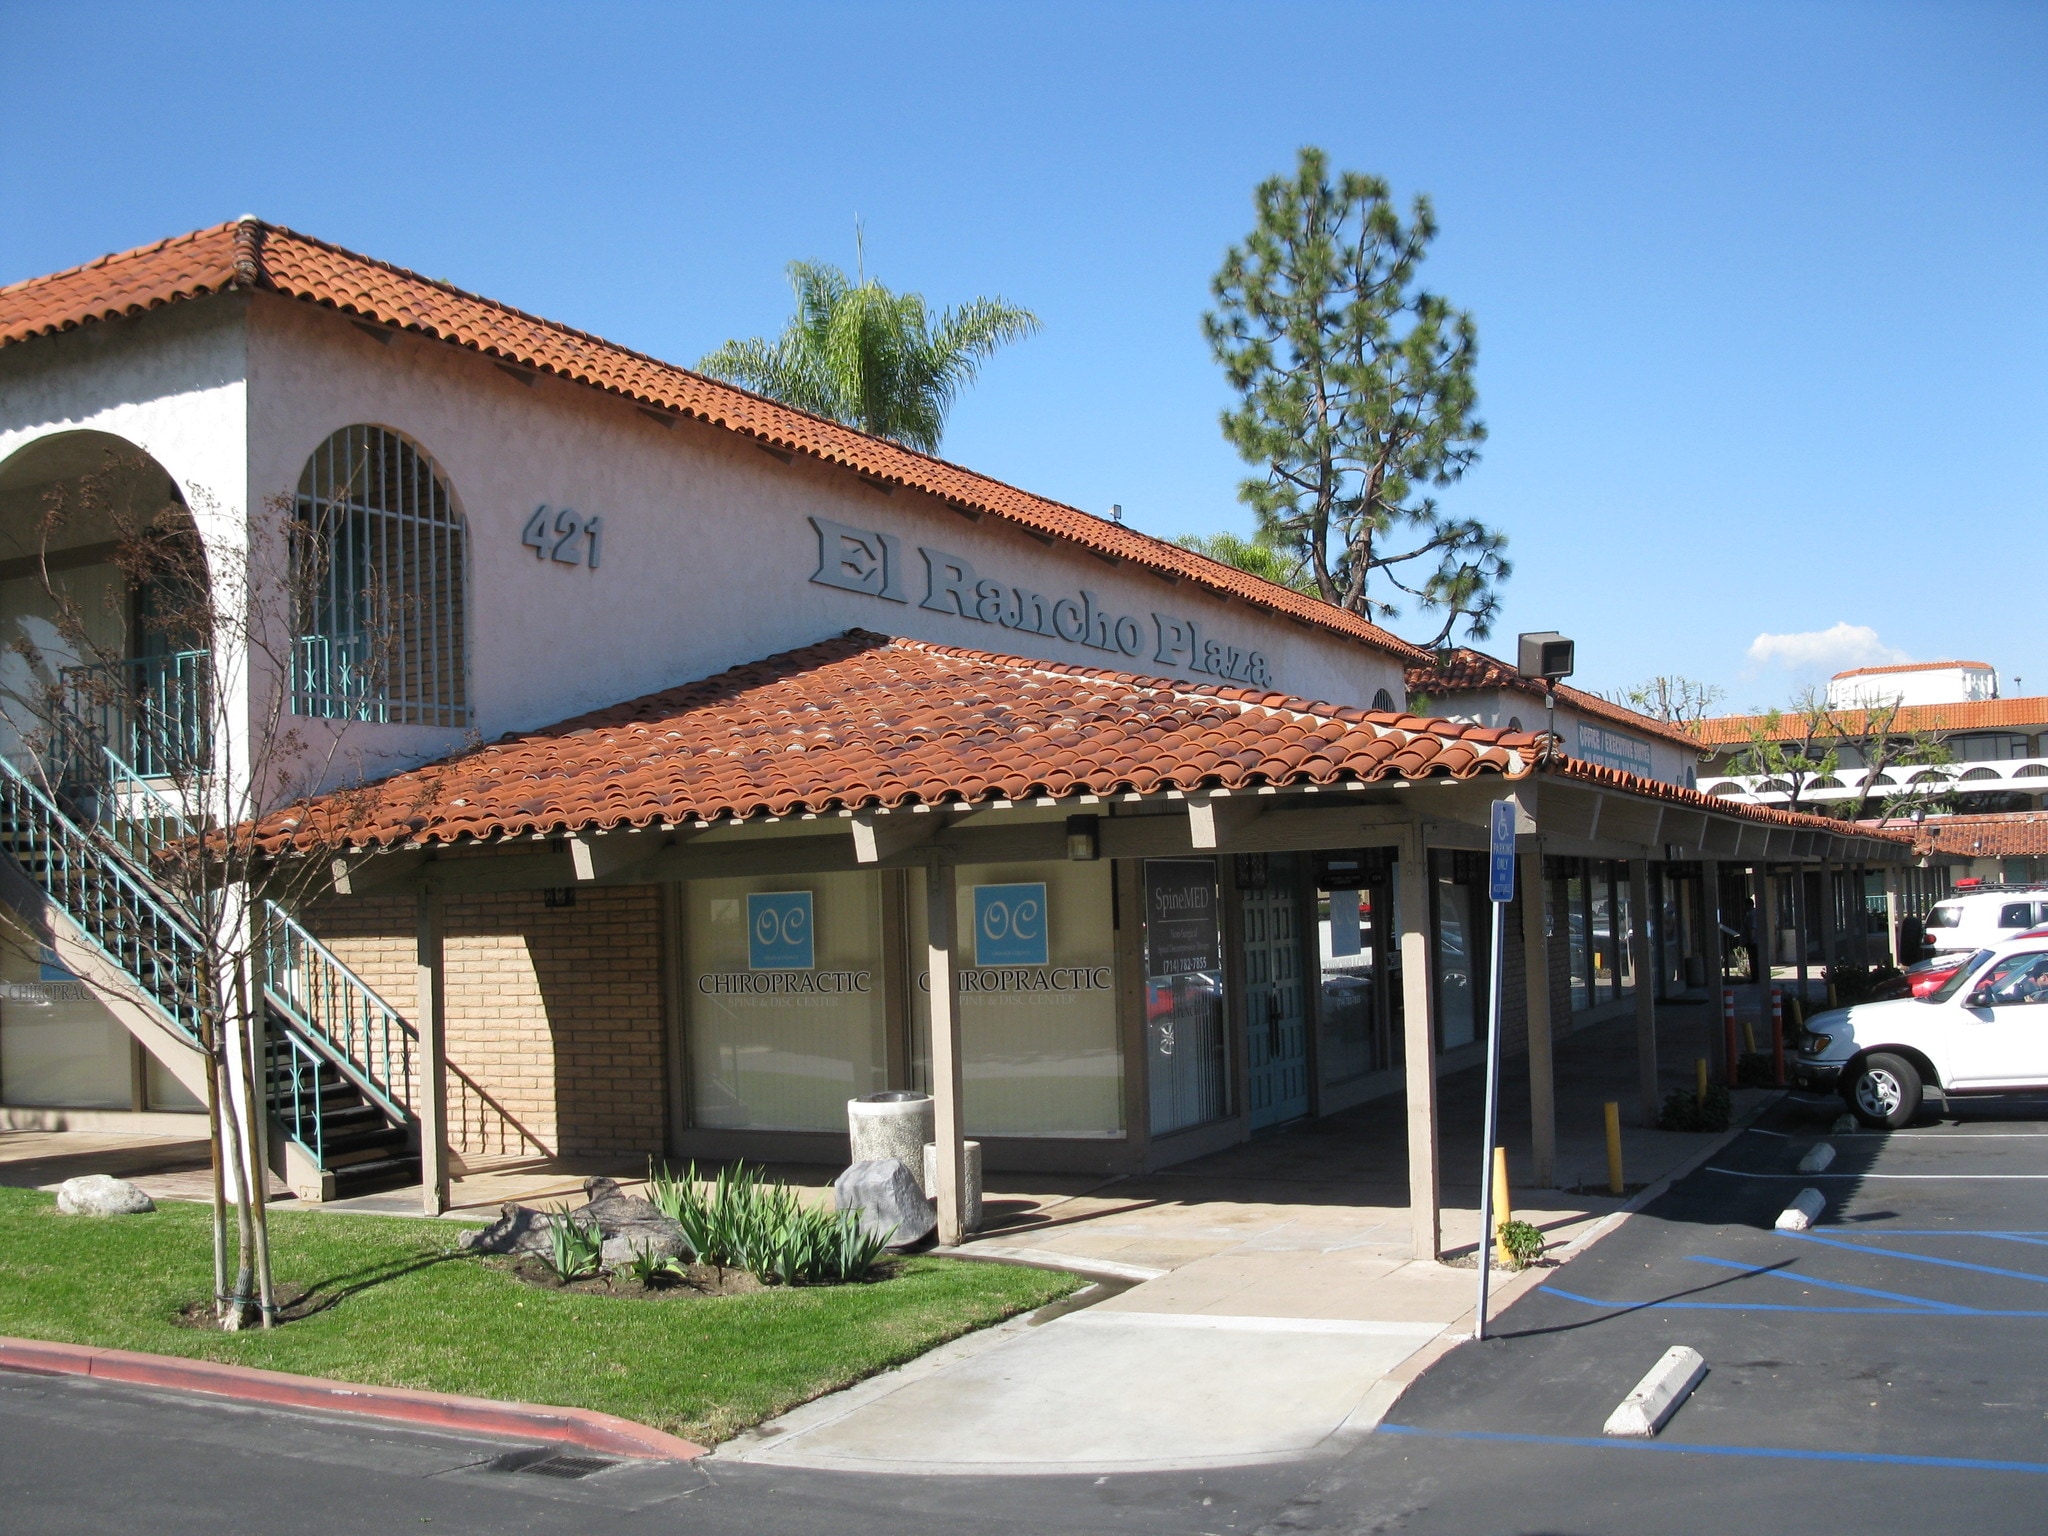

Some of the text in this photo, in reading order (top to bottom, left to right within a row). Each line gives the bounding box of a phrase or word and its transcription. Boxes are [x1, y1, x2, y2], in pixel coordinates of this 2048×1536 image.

[522, 504, 602, 569] 421
[808, 516, 1273, 688] El Rancho Plaza
[1580, 725, 1600, 750] OFFICE
[1493, 842, 1513, 856] PARKING
[1496, 857, 1509, 871] ONLY
[1155, 887, 1209, 918] SpineMED
[756, 907, 805, 945] OC
[984, 900, 1038, 940] OC
[1163, 956, 1207, 975] (714) 782-7855
[698, 971, 872, 995] CHIROPRACTIC
[917, 967, 1112, 993] CIROPRACTIC
[9, 983, 98, 1002] CHIROPRAC
[728, 996, 757, 1008] SPINE
[770, 996, 794, 1008] DISC
[796, 996, 839, 1008] CENTER
[959, 994, 986, 1006] PINE
[999, 994, 1026, 1005] DISC
[1028, 993, 1076, 1005] CENTER
